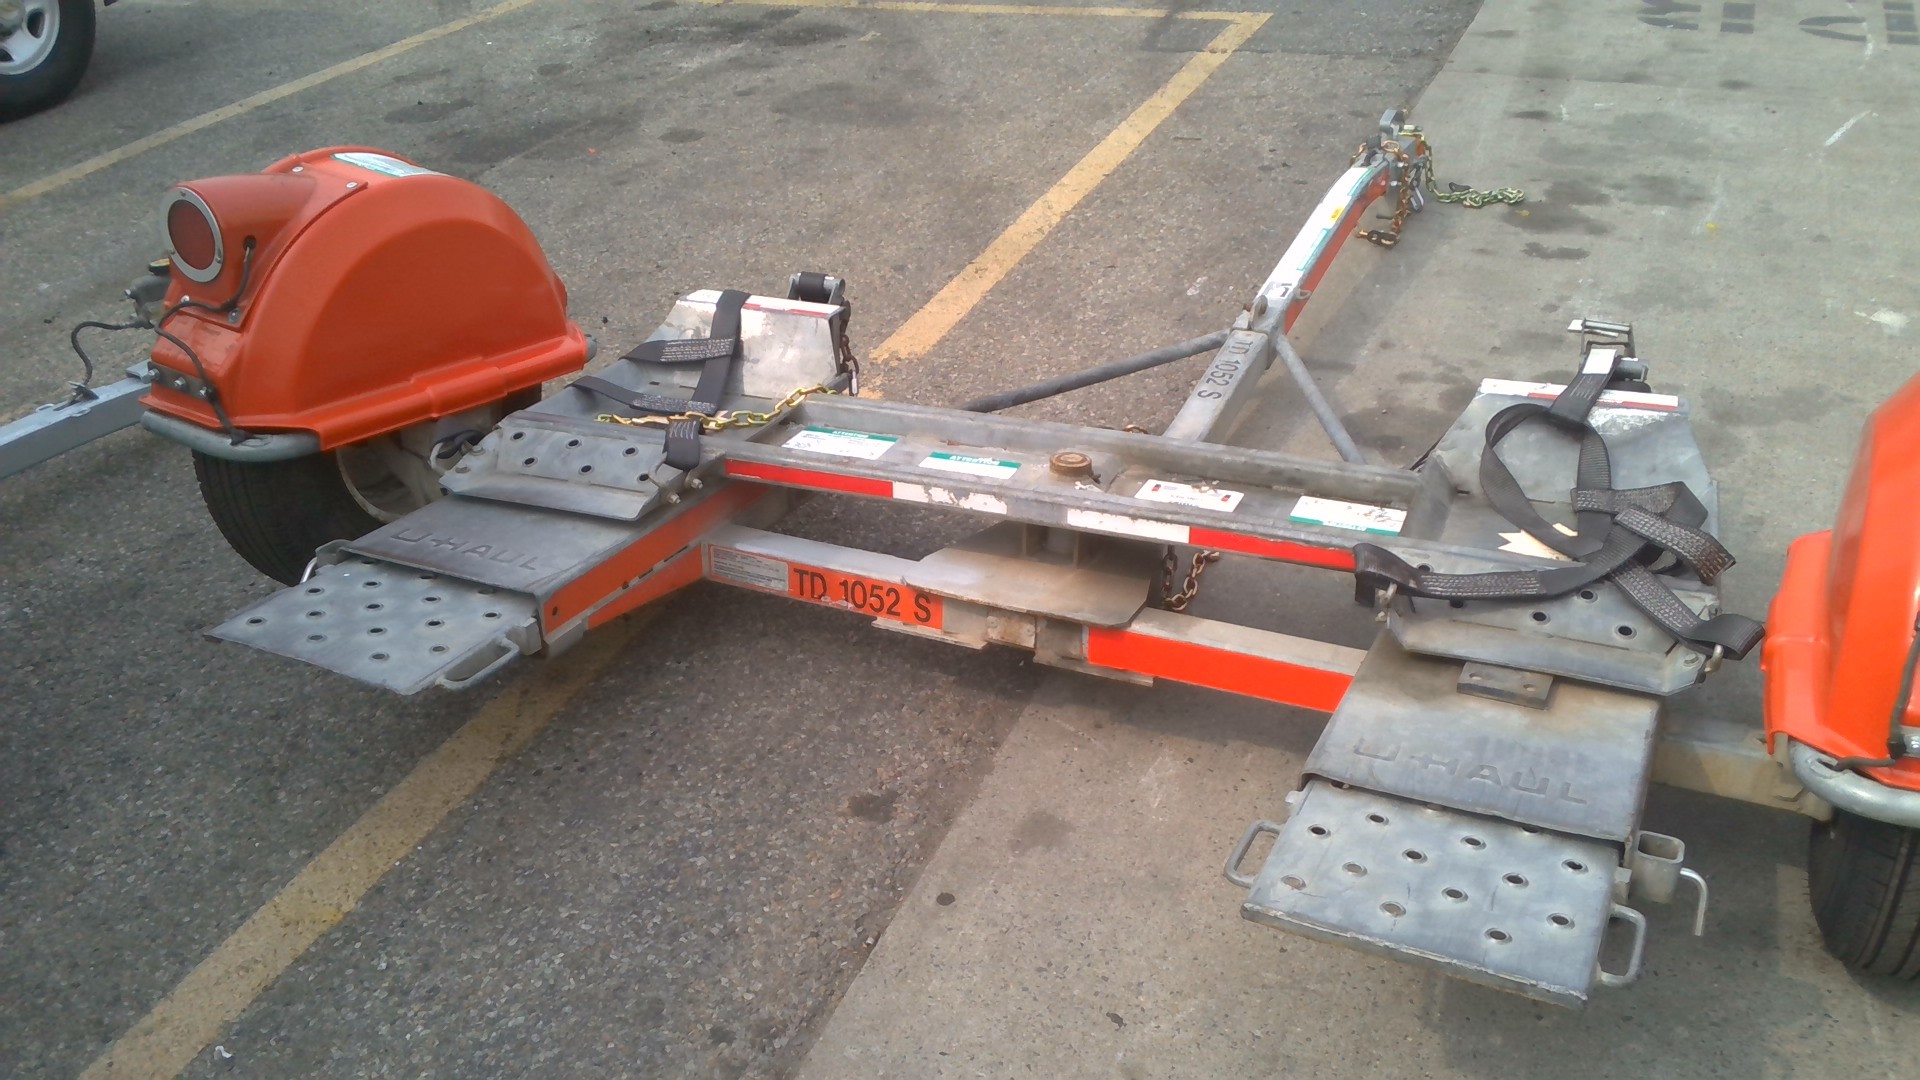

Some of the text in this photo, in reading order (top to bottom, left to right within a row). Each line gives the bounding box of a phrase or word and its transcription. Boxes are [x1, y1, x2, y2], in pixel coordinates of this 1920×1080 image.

[1197, 341, 1253, 399] TD 1052 S
[950, 454, 1000, 466] ATTENTION
[793, 568, 827, 600] TD
[839, 579, 901, 616] 1052
[913, 592, 931, 623] S
